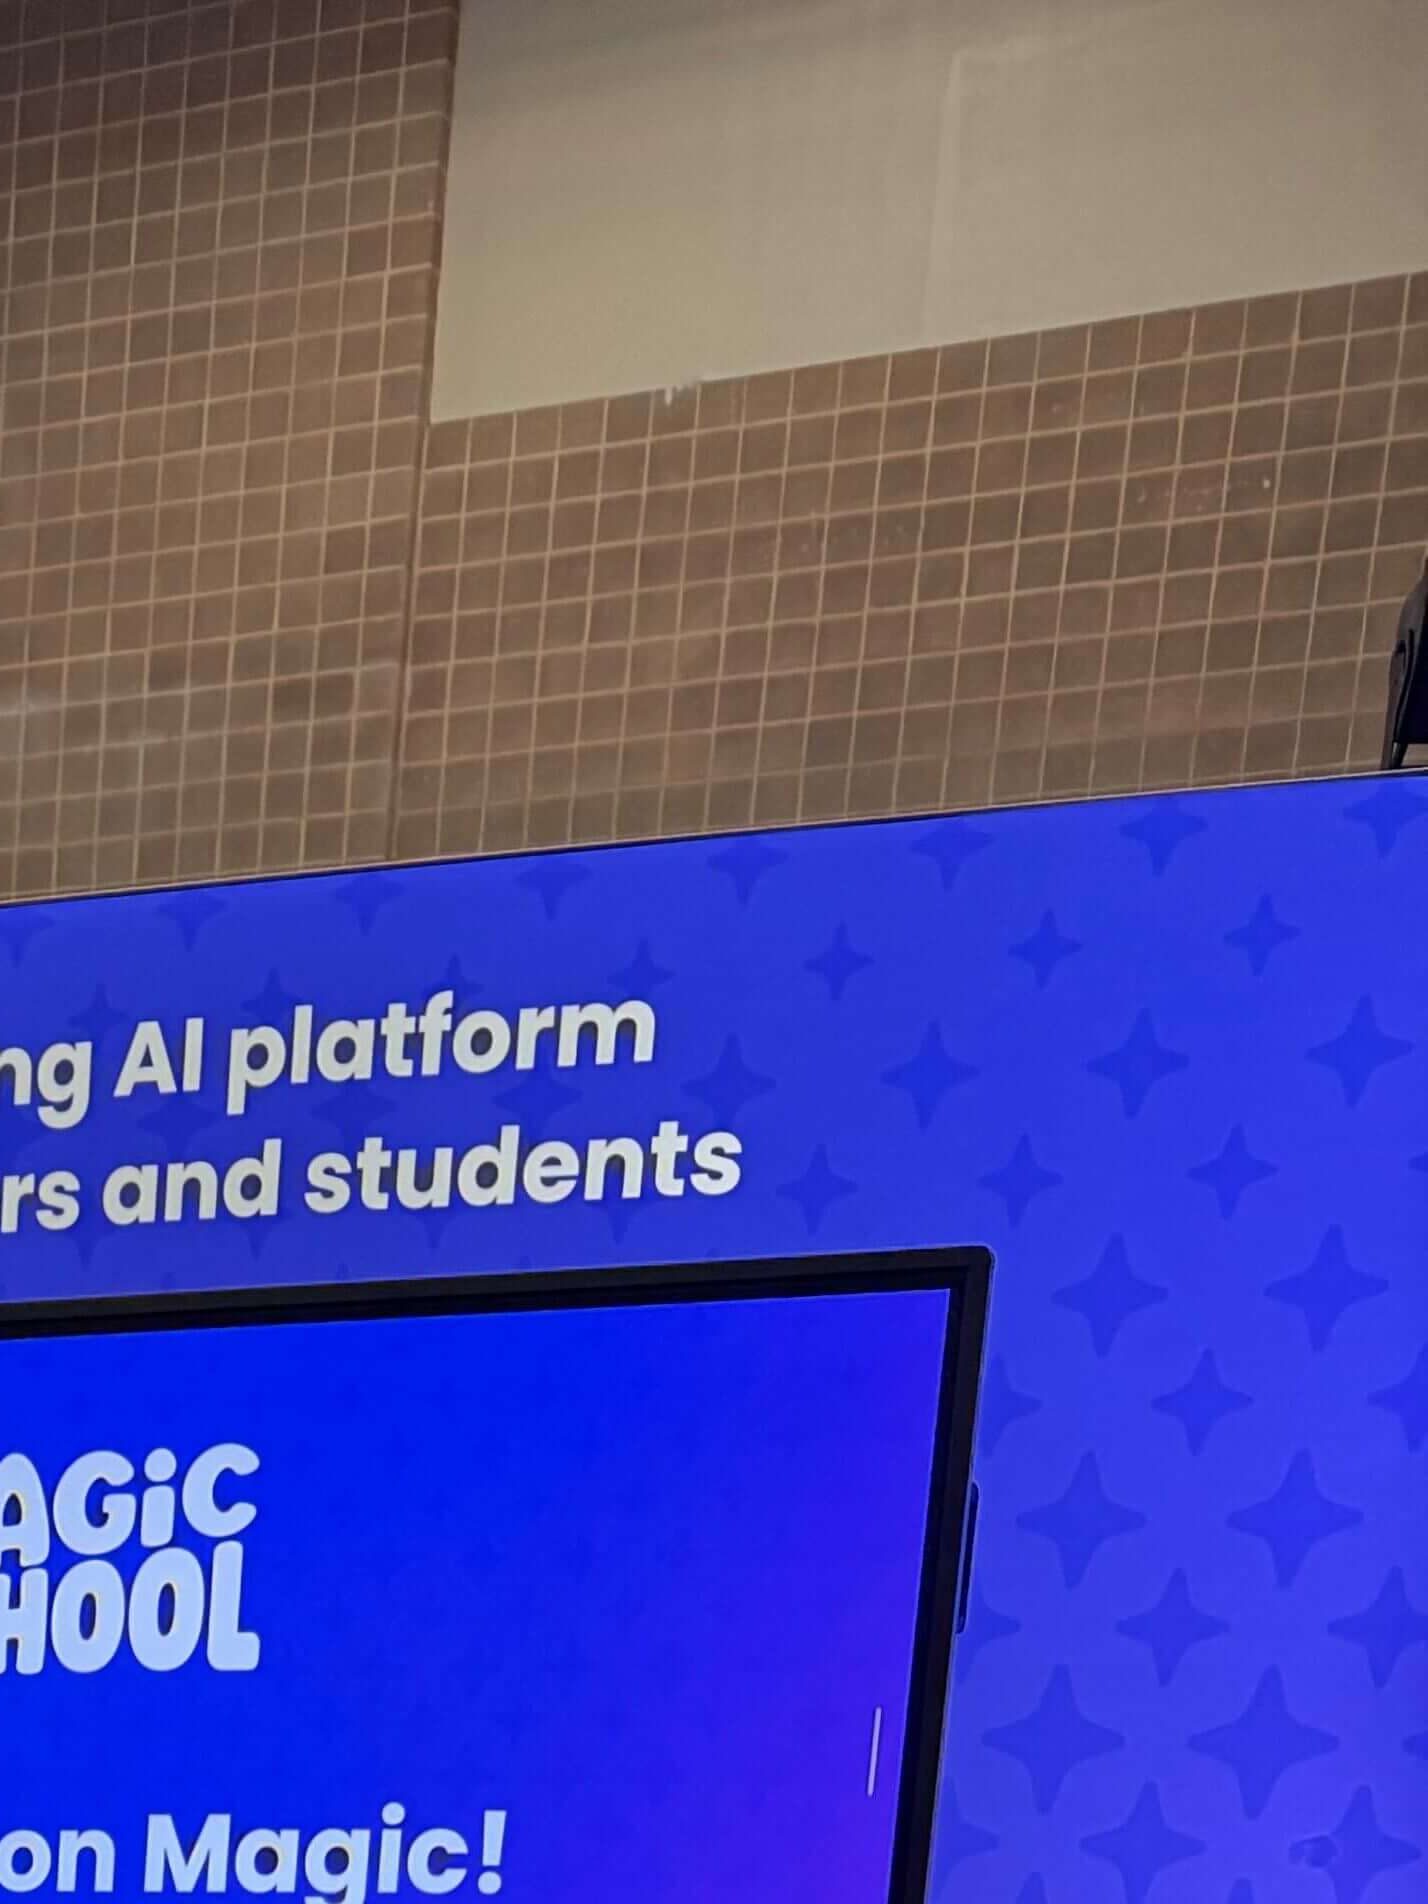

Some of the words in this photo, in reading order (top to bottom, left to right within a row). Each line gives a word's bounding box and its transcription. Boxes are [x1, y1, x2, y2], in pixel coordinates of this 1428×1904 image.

[113, 1016, 204, 1097] AI
[226, 989, 657, 1116] platform
[101, 1137, 282, 1226] and
[303, 1120, 743, 1214] students
